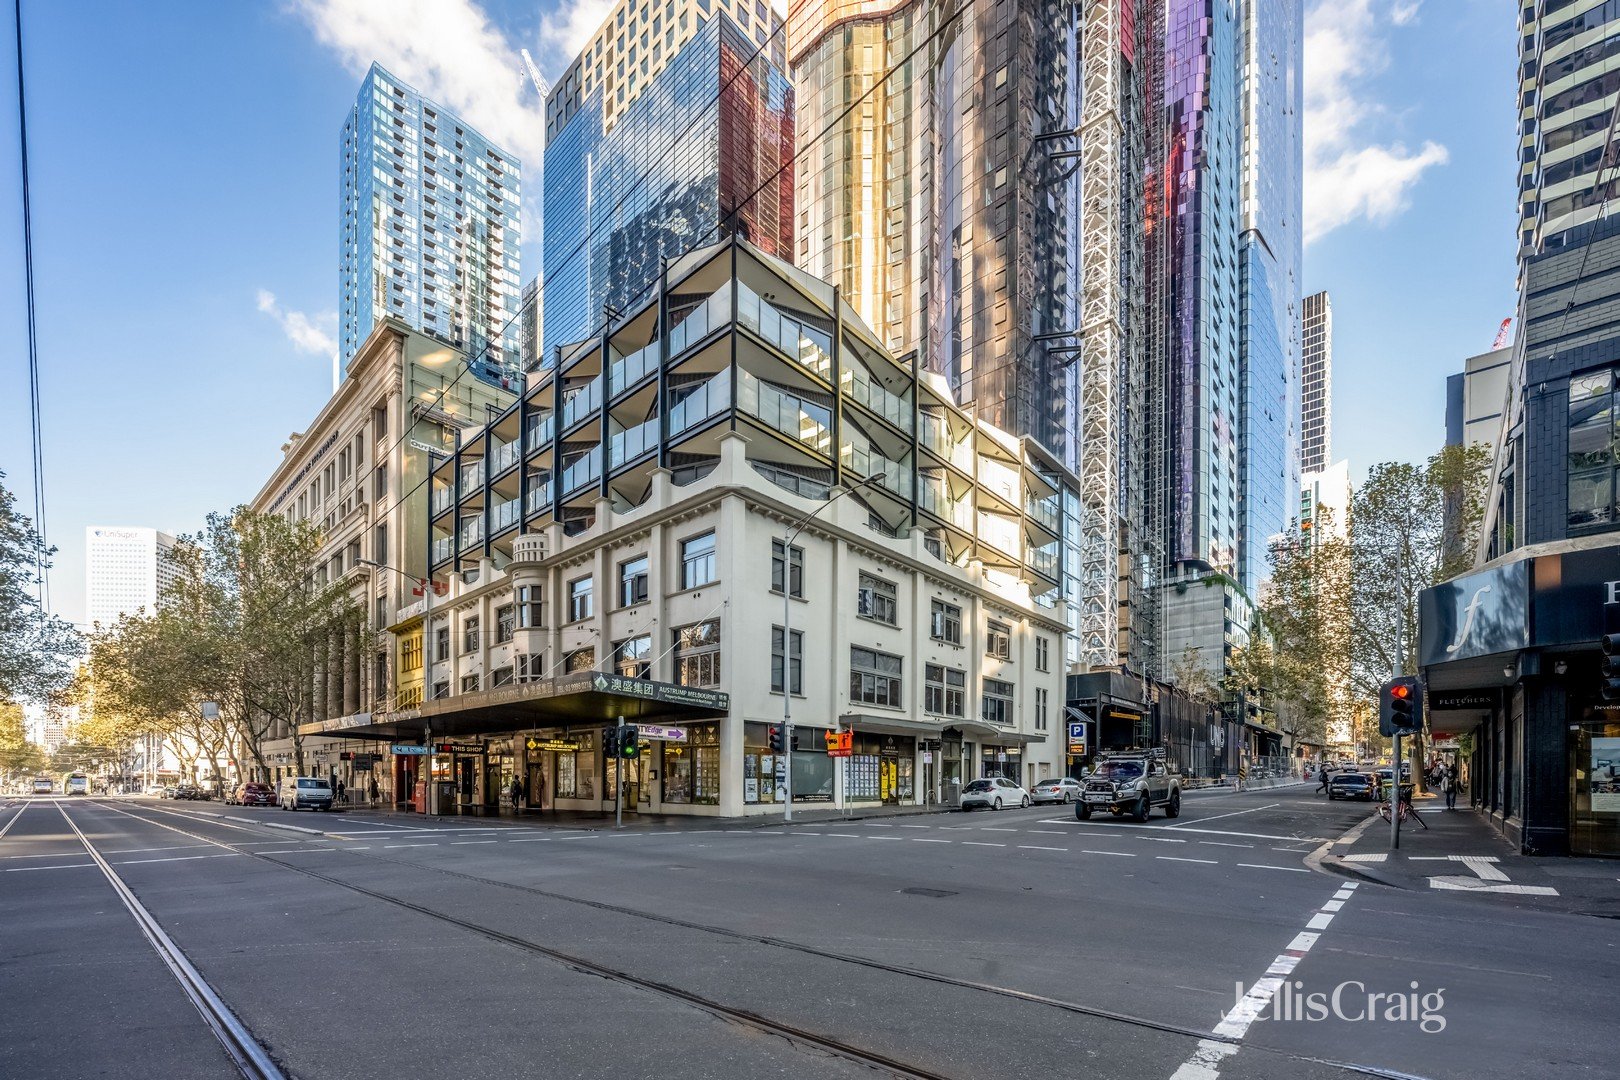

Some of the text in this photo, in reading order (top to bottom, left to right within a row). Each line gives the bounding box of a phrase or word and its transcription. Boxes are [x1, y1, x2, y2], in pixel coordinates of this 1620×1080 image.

[104, 530, 138, 539] UniSuper
[611, 678, 654, 696] 澳盛集团
[659, 686, 688, 696] AUSTRUMP
[688, 690, 717, 701] MELBOURNE
[1439, 697, 1492, 705] FLETCHERS
[1073, 726, 1081, 736] P
